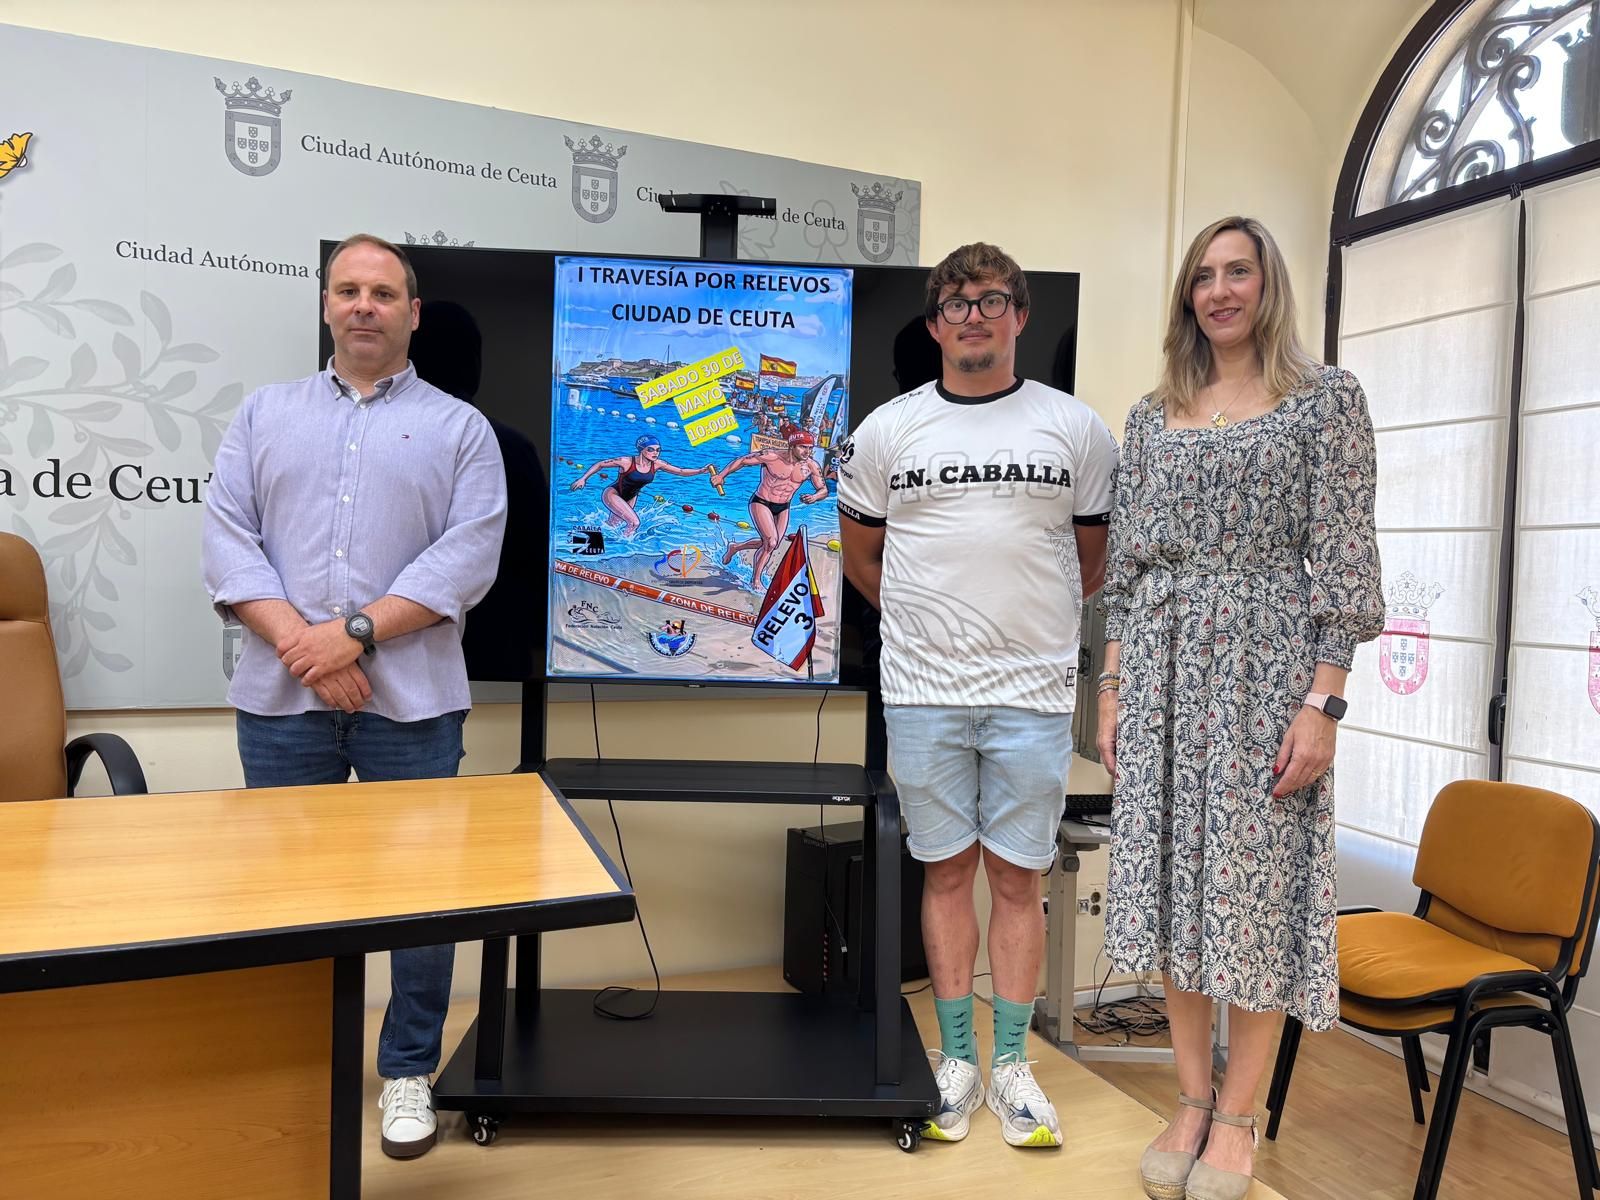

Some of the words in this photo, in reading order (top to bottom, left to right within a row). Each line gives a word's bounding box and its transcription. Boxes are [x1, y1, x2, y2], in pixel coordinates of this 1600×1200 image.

[301, 135, 372, 161] Ciudad
[377, 147, 476, 177] Autónoma
[481, 163, 503, 180] de
[507, 167, 558, 189] Ceuta
[782, 207, 800, 224] de
[803, 211, 845, 231] Ceuta
[116, 240, 193, 265] Ciudad
[199, 250, 309, 279] Autónoma
[578, 266, 583, 283] I
[590, 266, 689, 288] TRAVESÍA
[694, 272, 737, 290] POR
[742, 275, 830, 294] RELEVOS
[611, 303, 691, 325] CIUDAD
[697, 307, 724, 326] DE
[729, 309, 796, 329] CEUTA
[639, 369, 700, 406] SABADO
[701, 360, 720, 378] 30
[722, 351, 744, 370] DE
[677, 385, 725, 416] MAYO
[687, 412, 737, 442] 10:00h
[32, 458, 92, 500] de
[108, 464, 213, 504] Ceu
[889, 468, 933, 491] C.N.
[939, 463, 1072, 488] CABALLA
[568, 566, 580, 575] DE
[580, 569, 611, 585] RELEVO
[581, 600, 599, 613] FNC
[669, 595, 698, 610] ZONA
[700, 603, 716, 615] DE
[757, 582, 809, 647] RELEVO
[794, 612, 814, 631] 3
